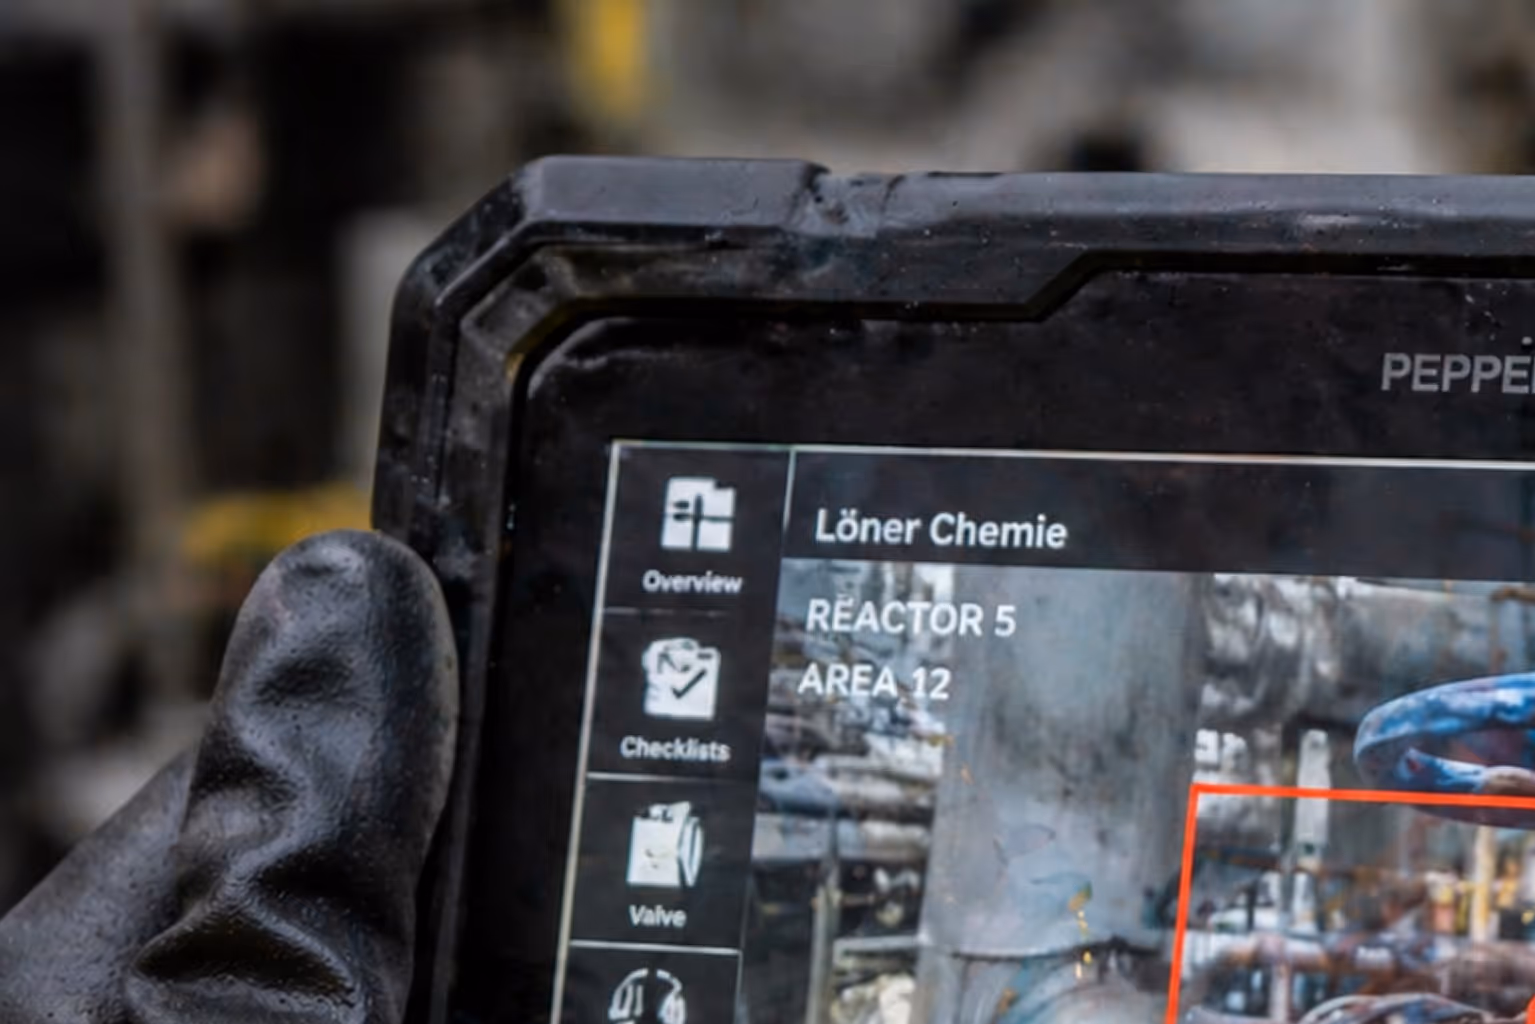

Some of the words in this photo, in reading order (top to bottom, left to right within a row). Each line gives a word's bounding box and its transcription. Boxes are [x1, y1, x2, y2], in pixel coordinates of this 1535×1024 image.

[814, 507, 921, 546] Löner
[929, 511, 1069, 550] Chemie
[641, 570, 743, 596] Overview
[805, 597, 983, 637] REACTOR
[993, 603, 1017, 638] 5
[797, 662, 900, 699] AREA
[911, 666, 951, 700] 12
[619, 735, 731, 764] Checklists
[628, 903, 687, 929] Valve
